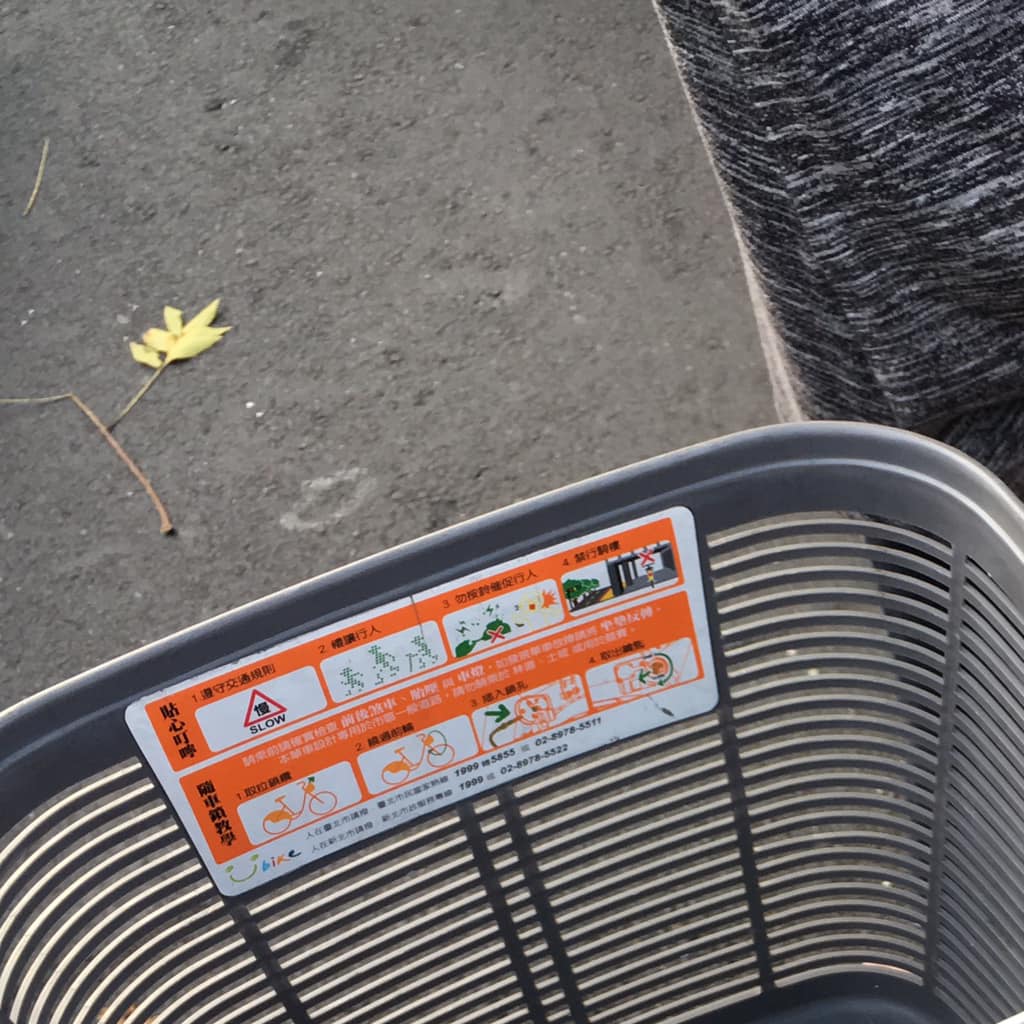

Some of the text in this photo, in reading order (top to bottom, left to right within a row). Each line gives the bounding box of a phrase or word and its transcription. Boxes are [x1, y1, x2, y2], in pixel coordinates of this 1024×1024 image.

[199, 662, 277, 699] 遵守交通規則
[158, 702, 199, 761] 貼心叮嚀
[248, 713, 288, 735] SLOW
[252, 700, 271, 717] 慢
[453, 761, 480, 778] 1999
[534, 715, 602, 748] 02-8978-5511
[458, 774, 484, 791] 1999
[499, 742, 569, 776] 02-8978-5522
[195, 779, 238, 848] 隨車鎖教學
